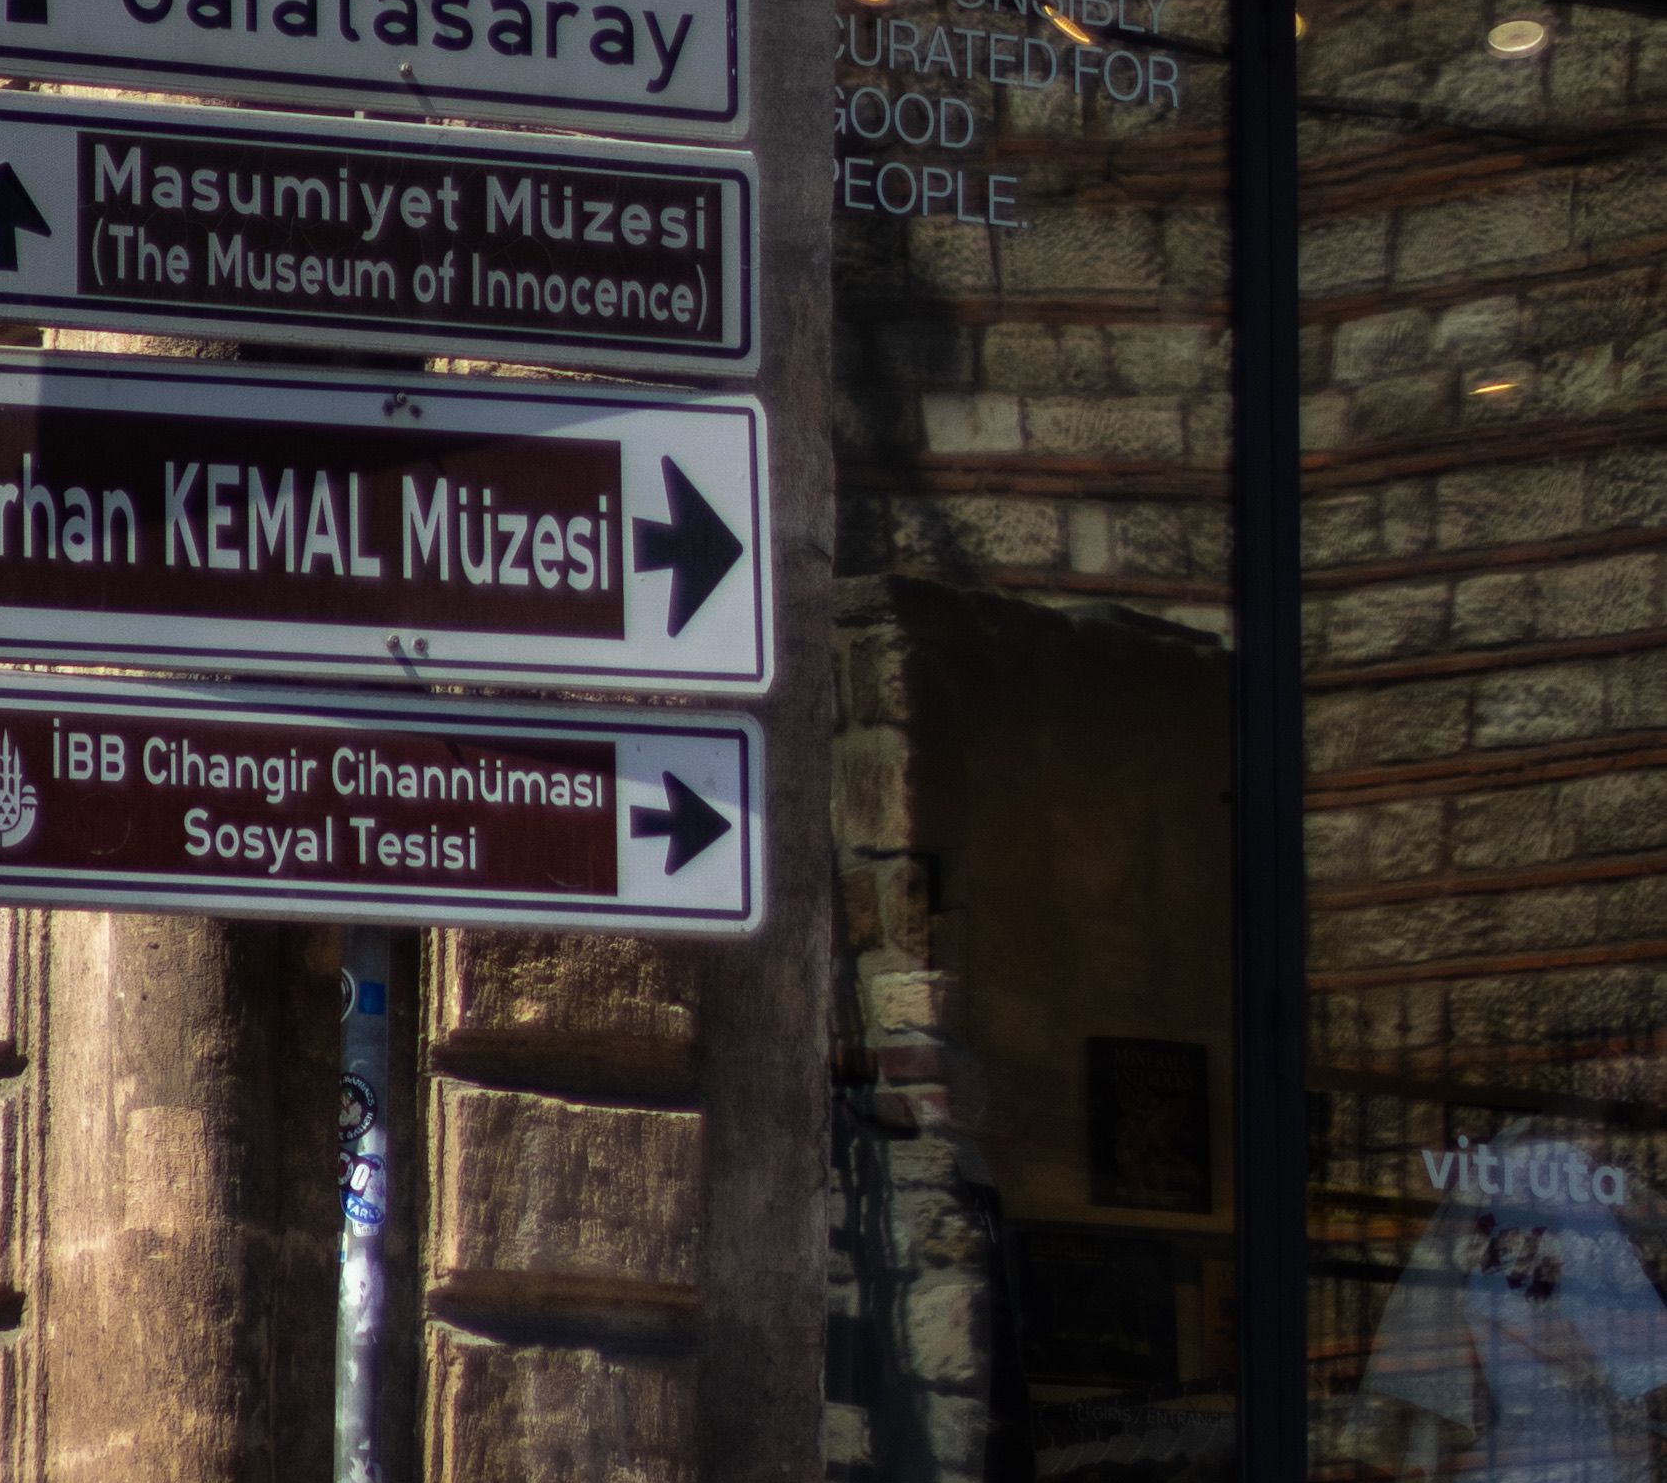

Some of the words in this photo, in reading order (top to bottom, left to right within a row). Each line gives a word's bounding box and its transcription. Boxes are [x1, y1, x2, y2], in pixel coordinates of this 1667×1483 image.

[1074, 45, 1178, 109] FOR
[95, 143, 458, 242] Masumiyet
[488, 176, 707, 250] Müzesi
[832, 157, 1028, 228] EOPLE.
[92, 223, 190, 287] (The
[208, 235, 396, 302] Museum
[413, 252, 455, 304] of
[472, 252, 707, 330] Innocence)
[165, 462, 381, 578] KEMAL
[403, 475, 609, 591] Müzesi
[53, 720, 126, 783] İBB
[143, 737, 316, 804] Cihangir
[333, 748, 603, 808] Cihannüması
[185, 809, 332, 873] Sosyal
[350, 817, 478, 870] Tesisi
[1421, 1134, 1625, 1206] vitruta
